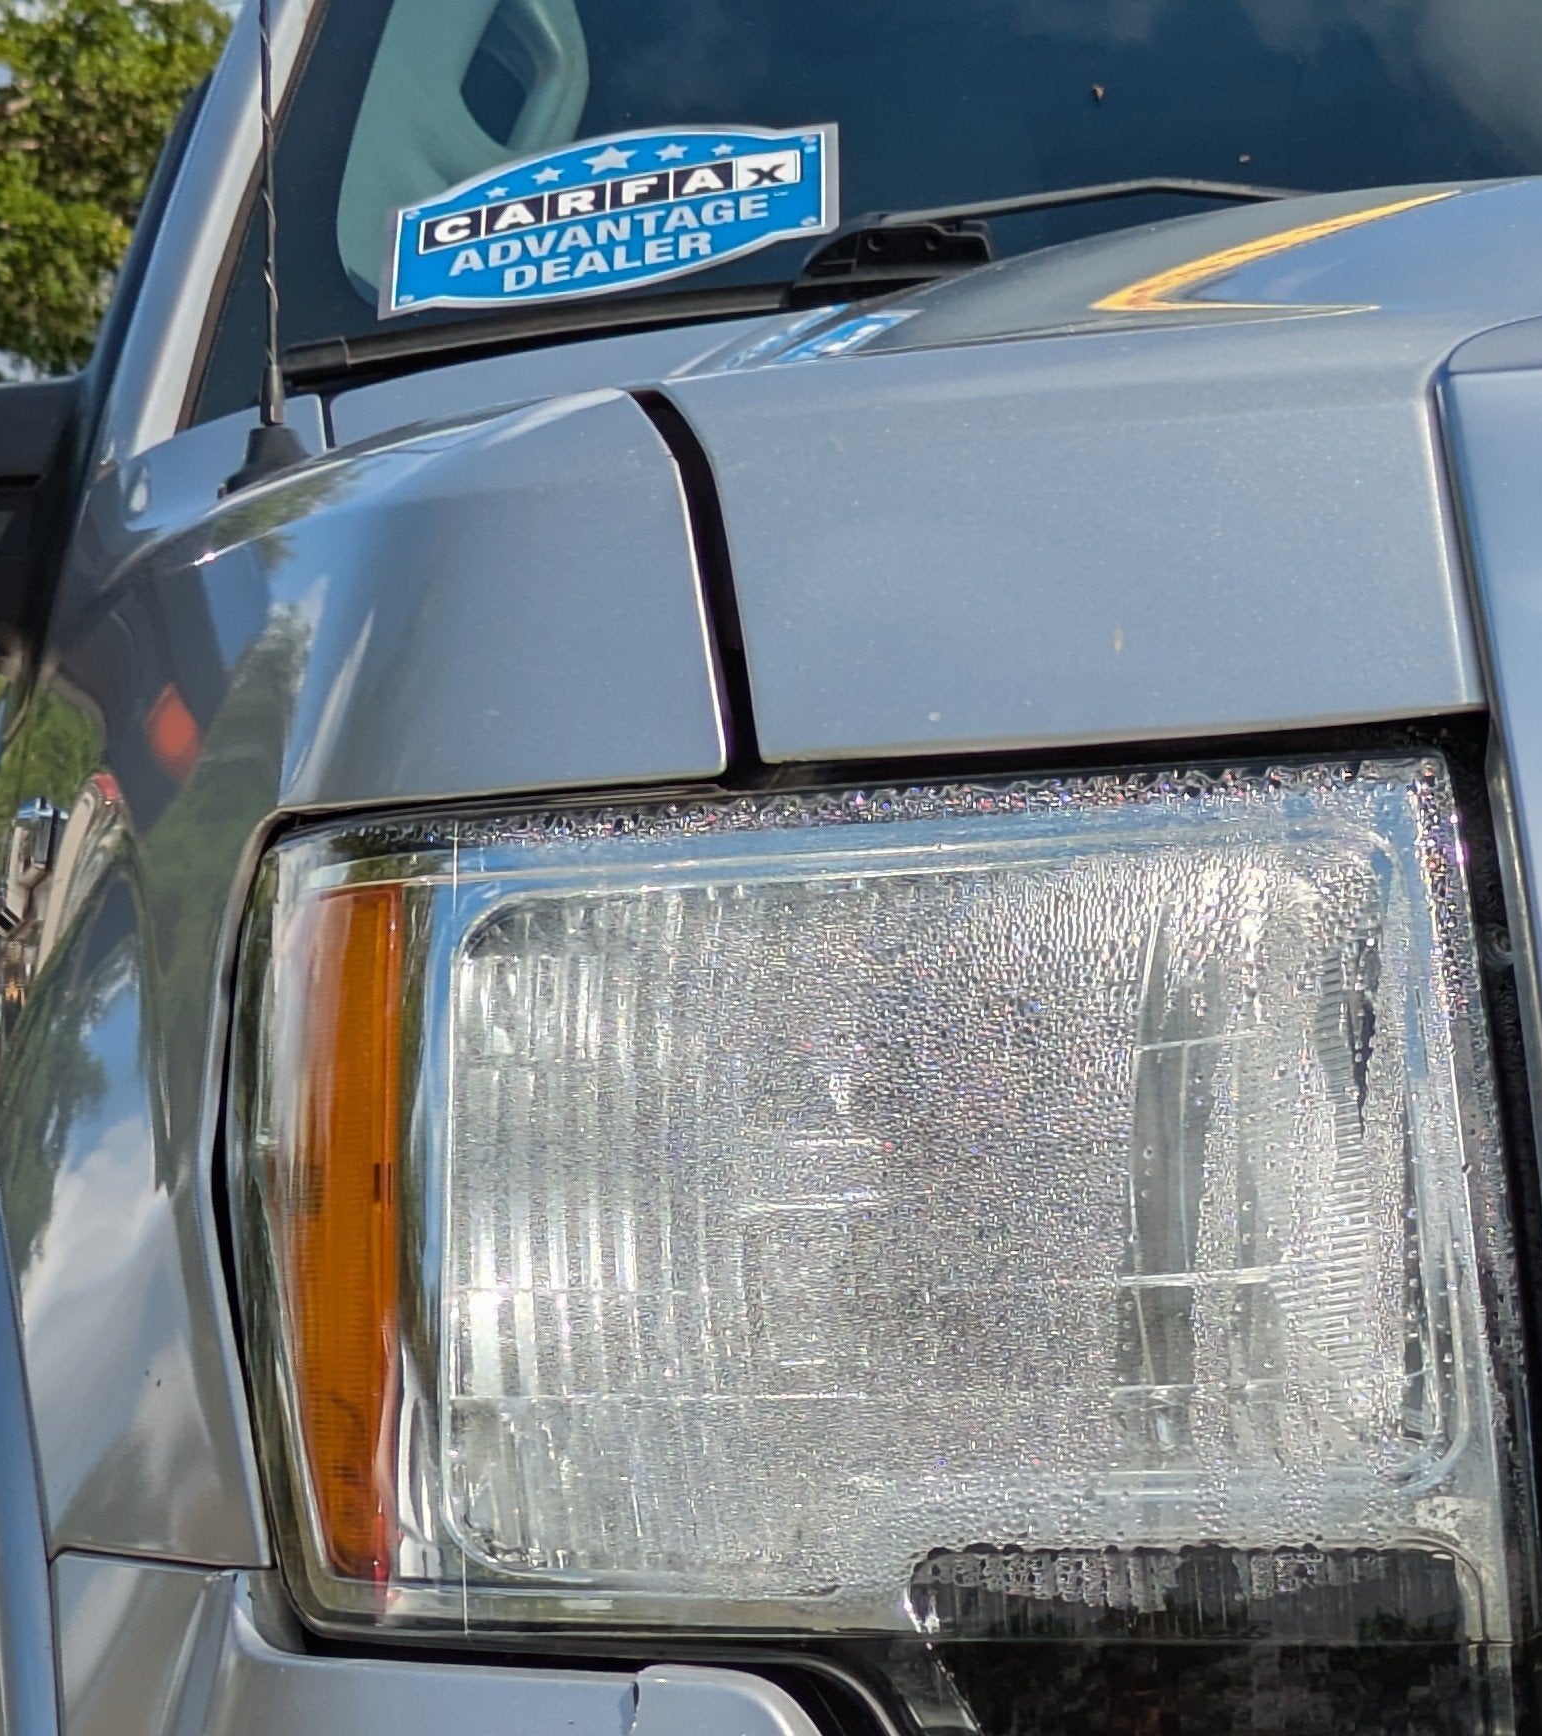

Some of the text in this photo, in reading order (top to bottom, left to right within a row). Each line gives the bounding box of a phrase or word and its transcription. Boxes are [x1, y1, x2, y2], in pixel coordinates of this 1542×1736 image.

[433, 161, 788, 244] CARFAX
[448, 194, 770, 277] ADVANTAGE
[502, 233, 713, 294] DEALER
